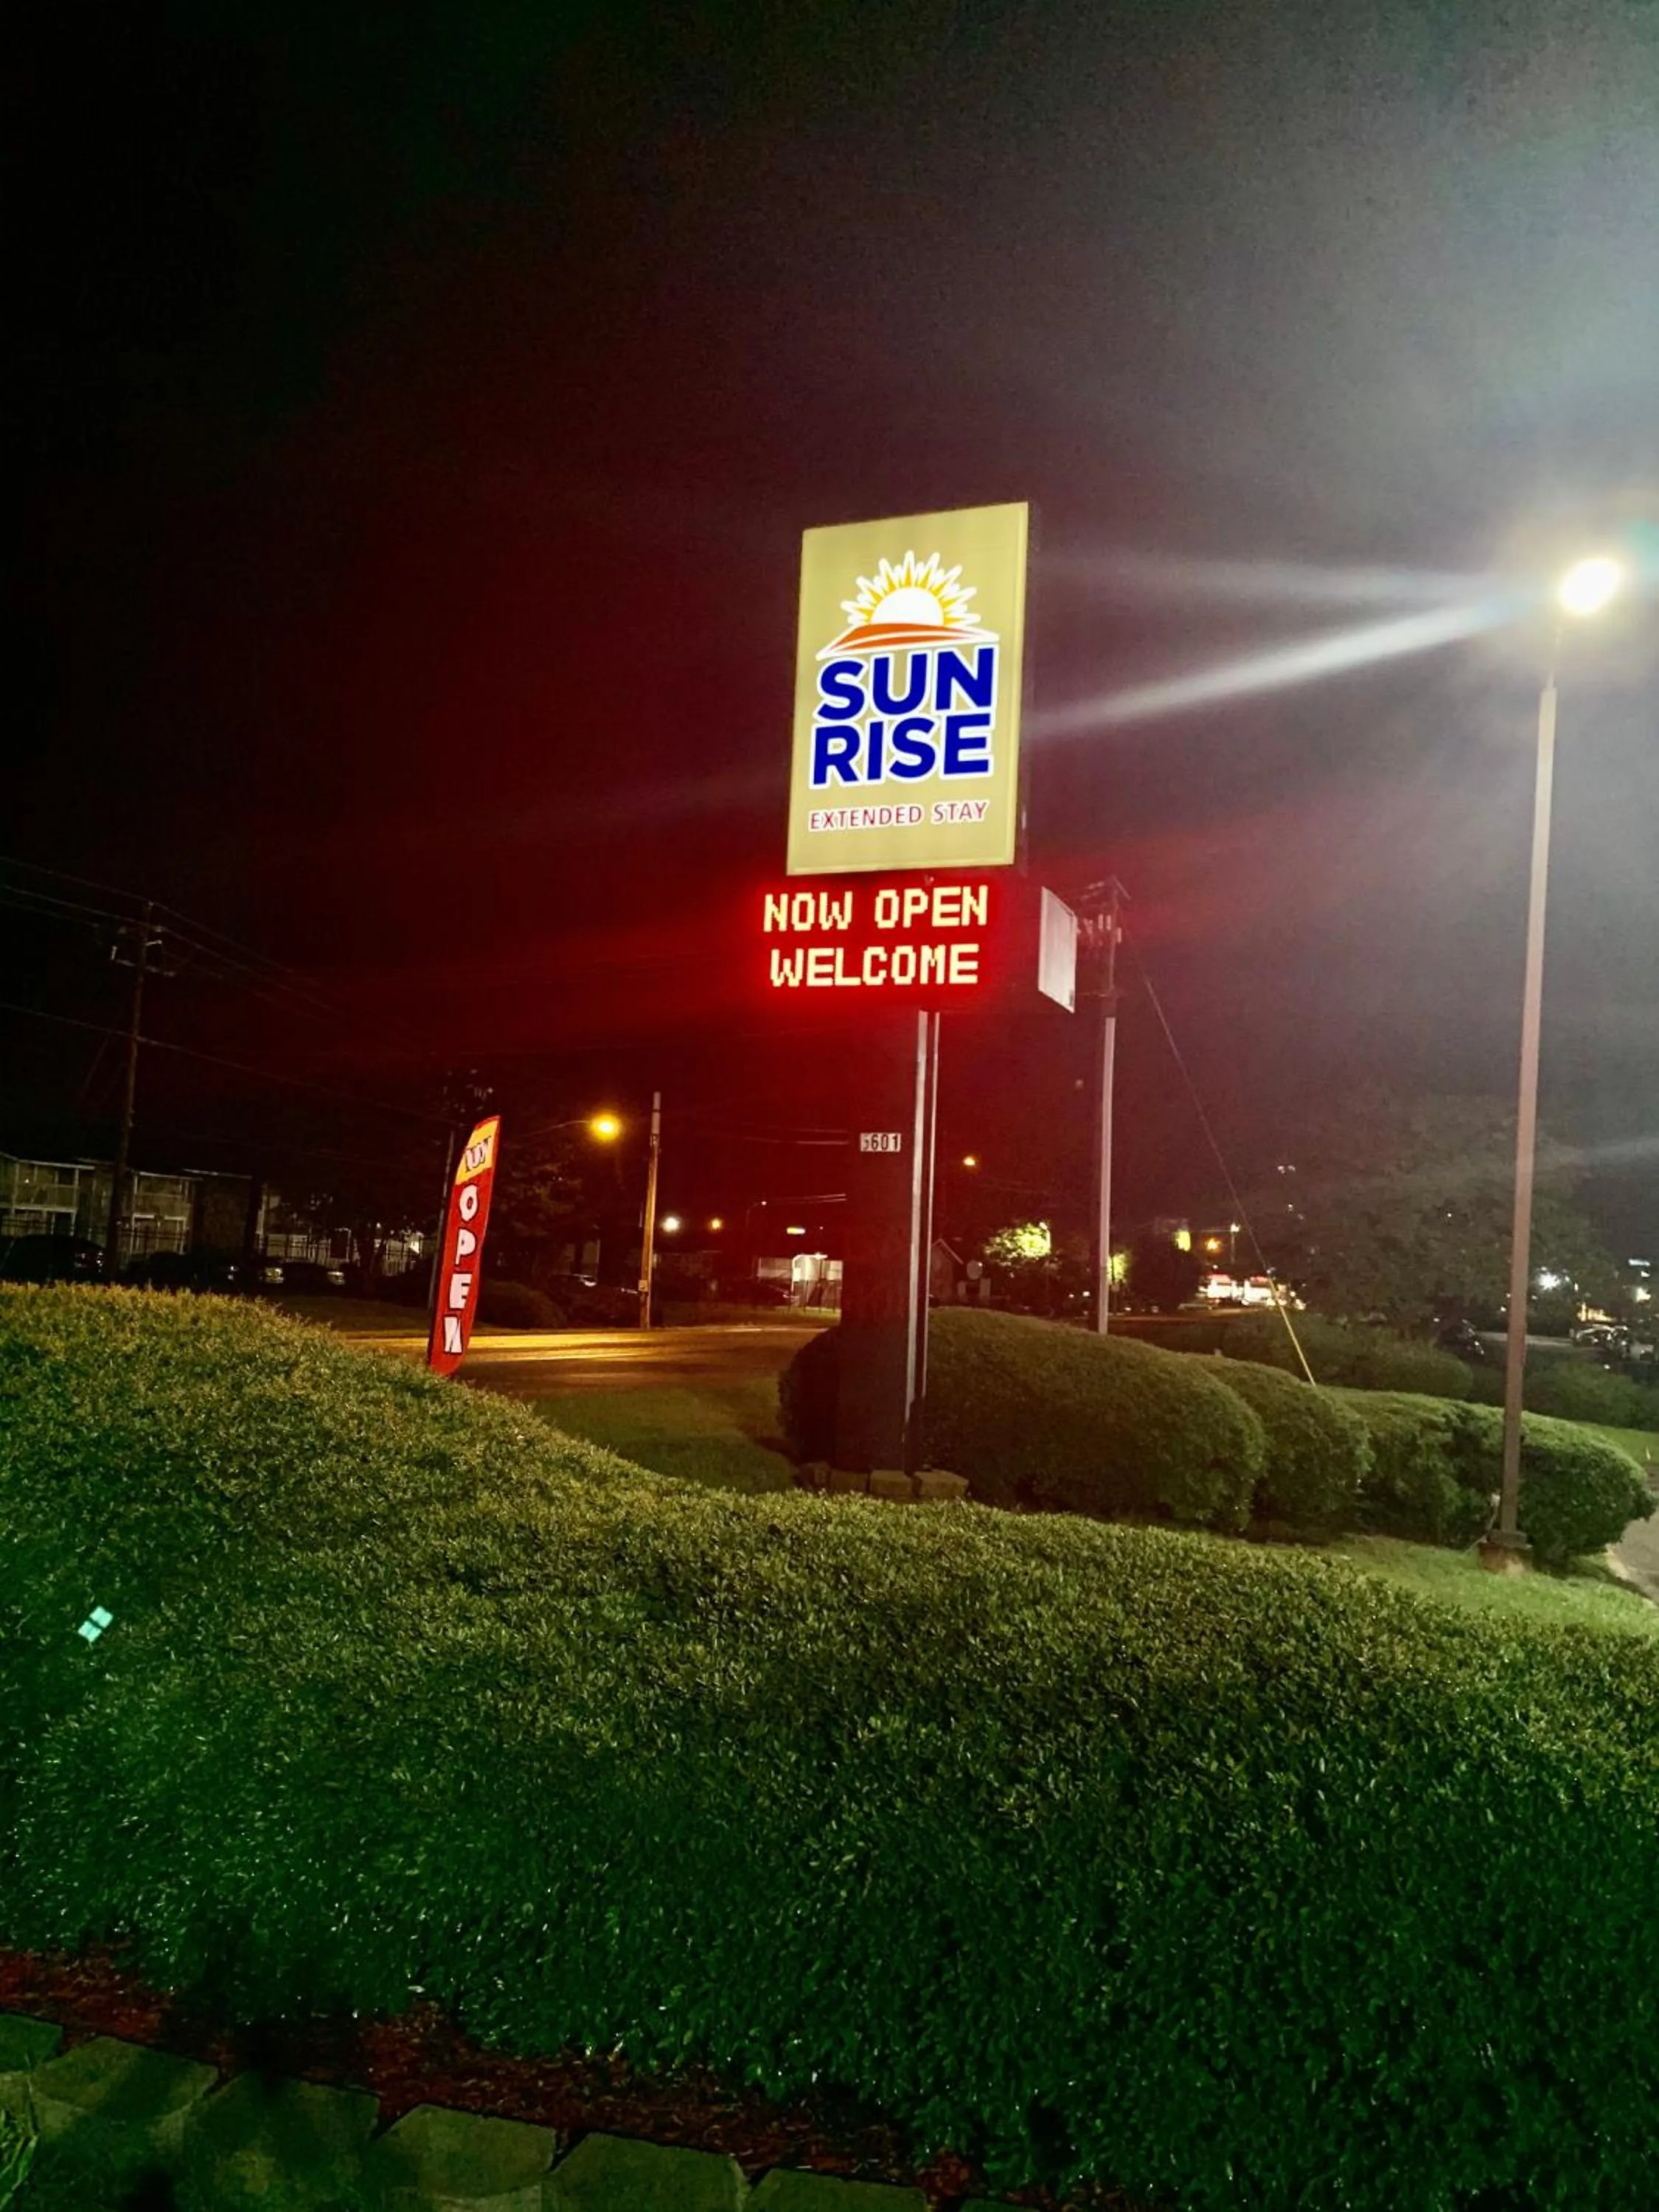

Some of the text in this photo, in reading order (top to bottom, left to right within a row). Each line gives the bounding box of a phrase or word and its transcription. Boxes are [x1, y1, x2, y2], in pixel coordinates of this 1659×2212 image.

[815, 646, 995, 721] SUN
[812, 712, 992, 786] RISE
[810, 801, 988, 831] EXTENDED STAY
[763, 885, 989, 933] NOW OPEN
[770, 943, 980, 987] WELCOME
[443, 1183, 479, 1354] OPEN
